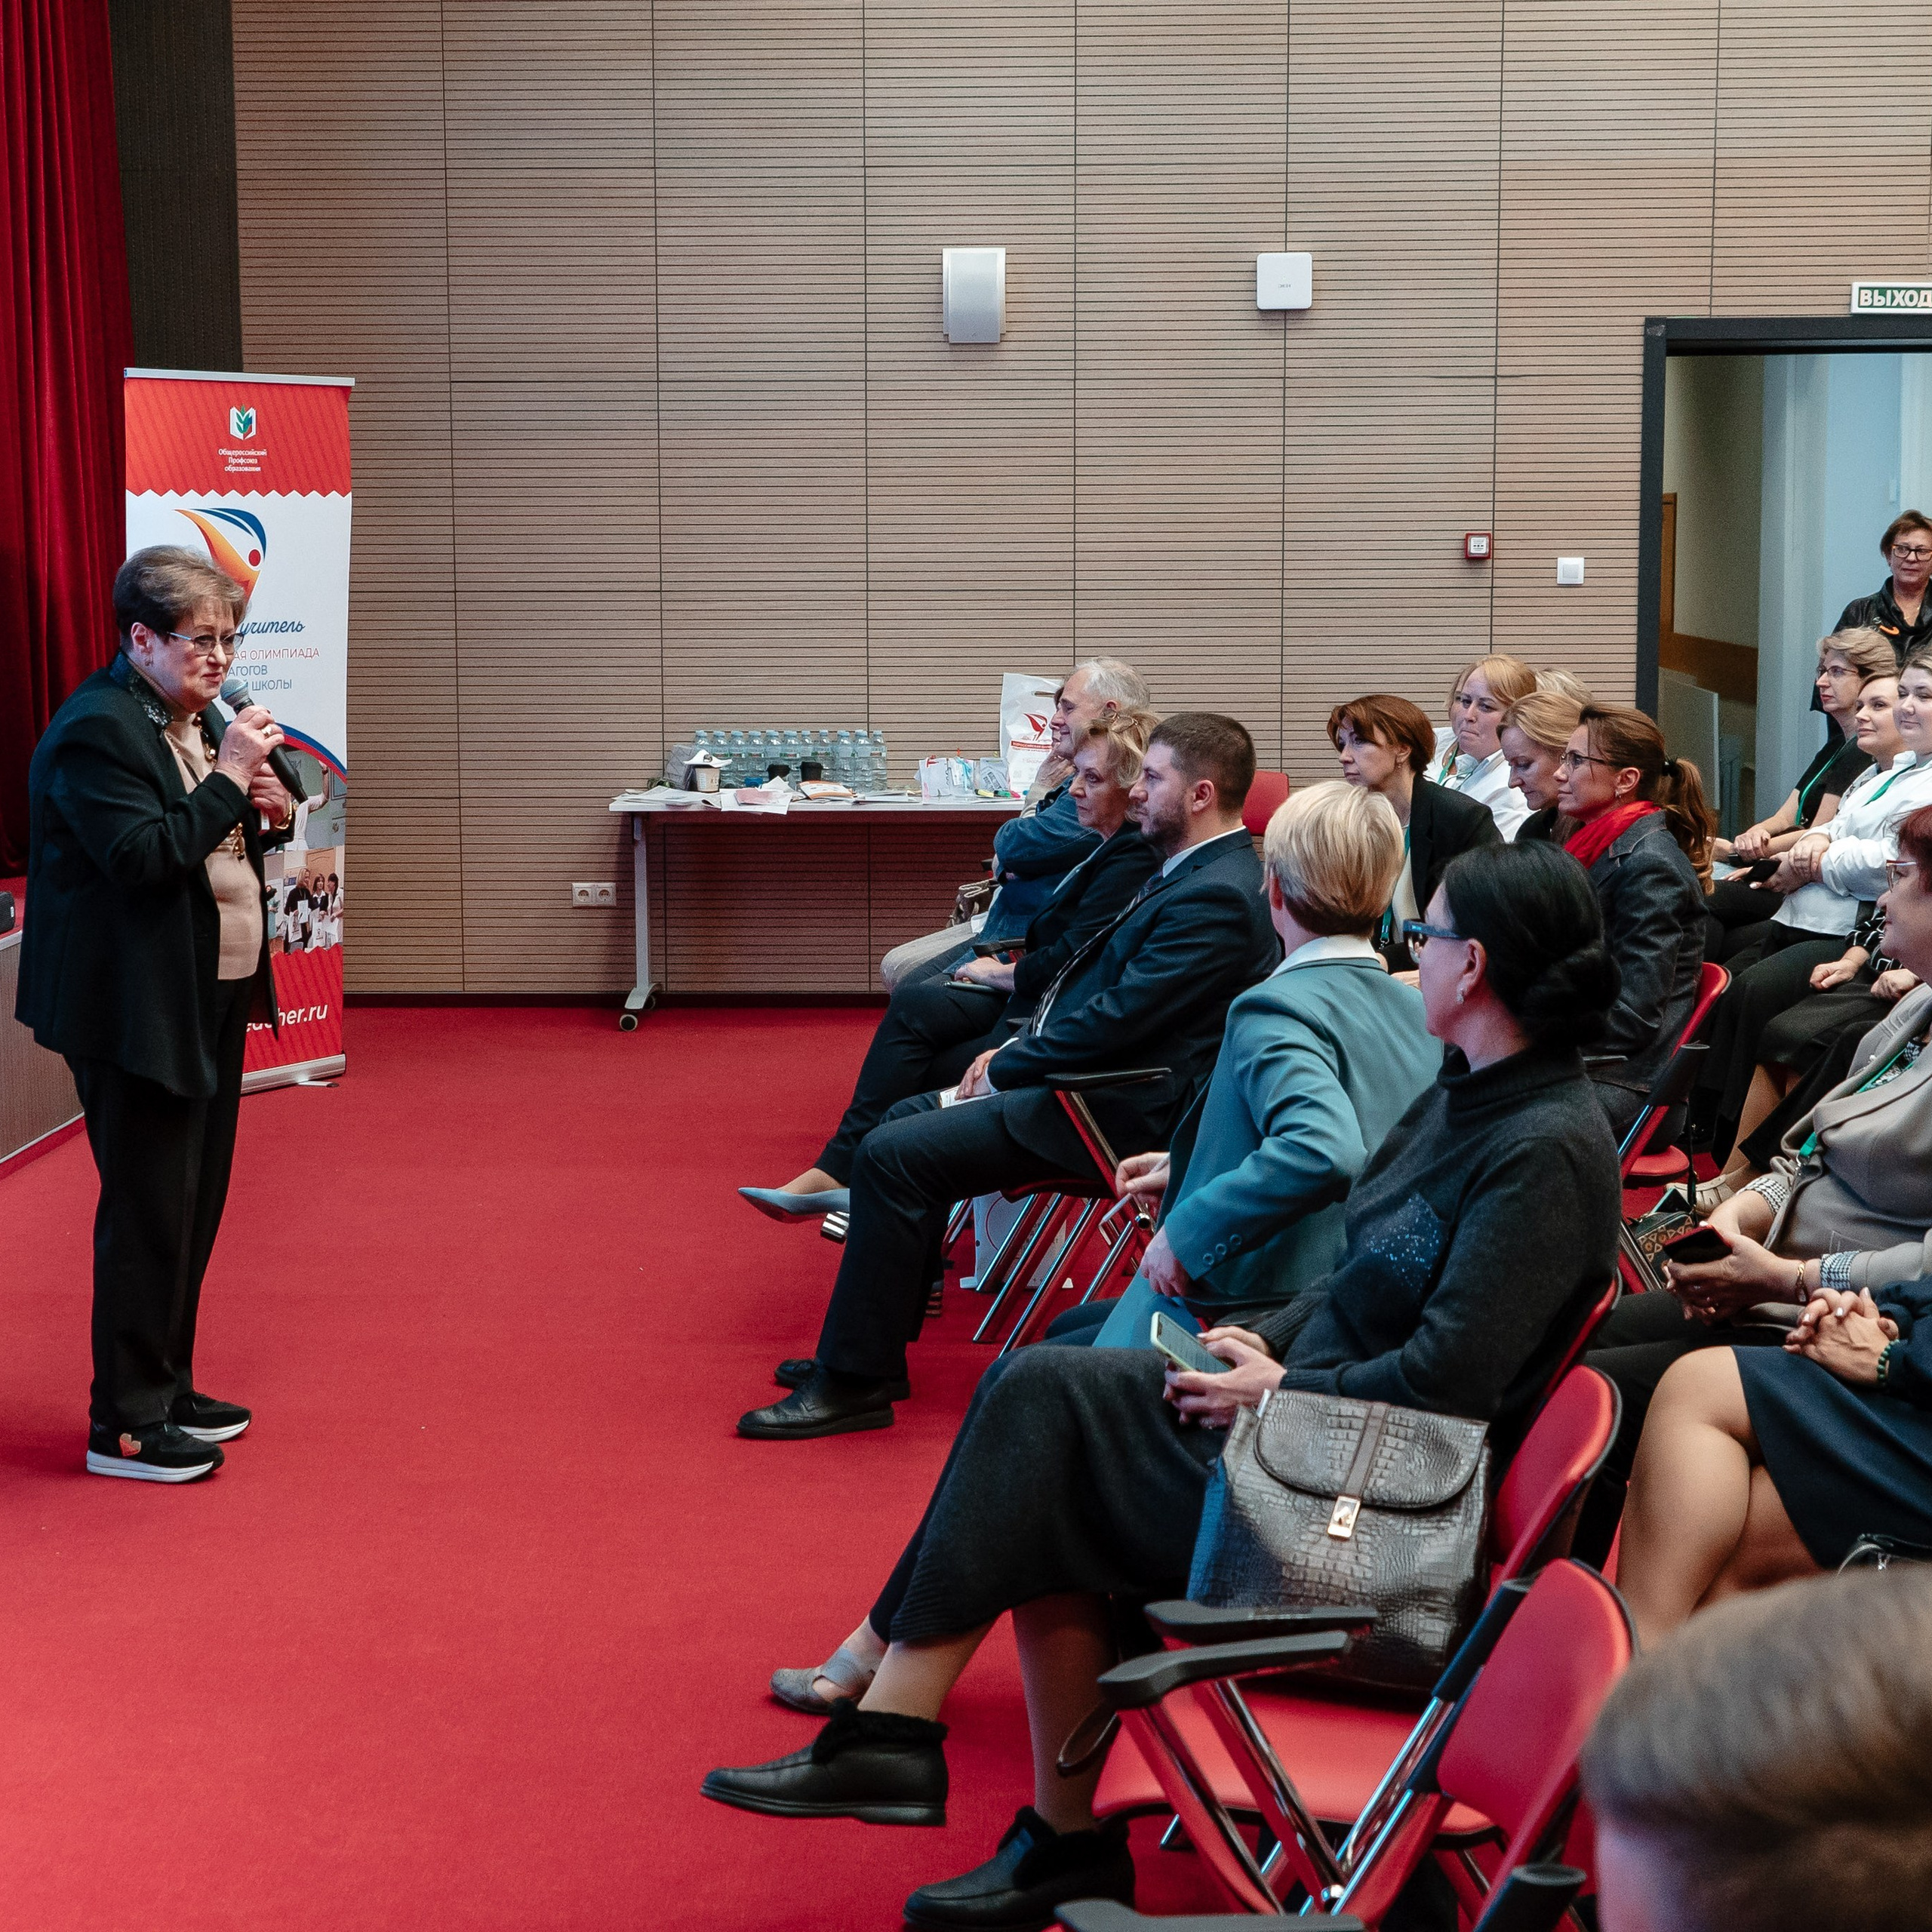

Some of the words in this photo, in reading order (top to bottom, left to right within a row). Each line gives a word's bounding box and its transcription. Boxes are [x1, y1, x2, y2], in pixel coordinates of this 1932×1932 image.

[1860, 289, 1932, 308] ВЫХОД
[218, 448, 267, 457] Общероссийский
[228, 457, 258, 465] Профсоюз
[224, 464, 261, 473] образования
[239, 620, 306, 635] учитель
[250, 648, 320, 660] ОЛИМПИАДА
[251, 678, 292, 691] ШКОЛЫ
